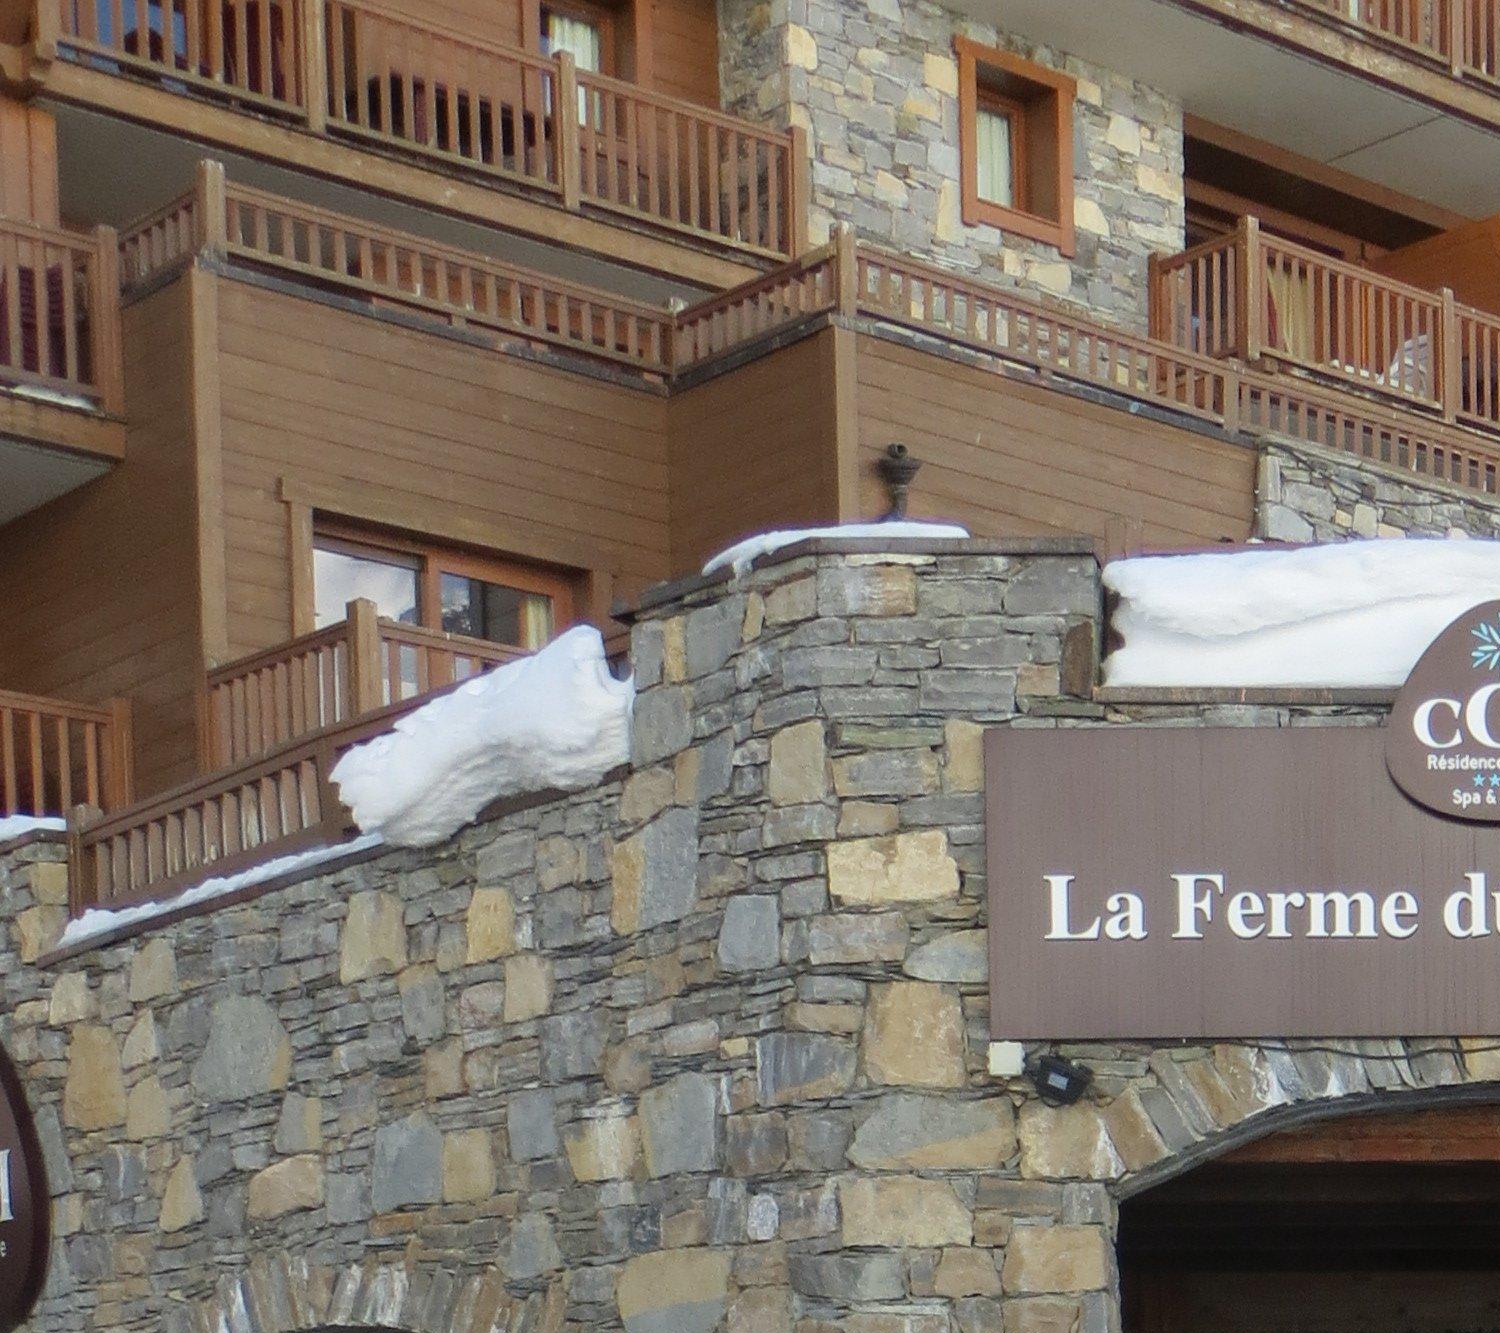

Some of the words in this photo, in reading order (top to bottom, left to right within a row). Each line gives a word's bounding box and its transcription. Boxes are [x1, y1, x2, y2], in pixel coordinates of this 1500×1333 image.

[1452, 788, 1481, 809] Spa
[1486, 790, 1497, 805] &
[1043, 874, 1148, 940] La
[1170, 873, 1420, 939] Ferme
